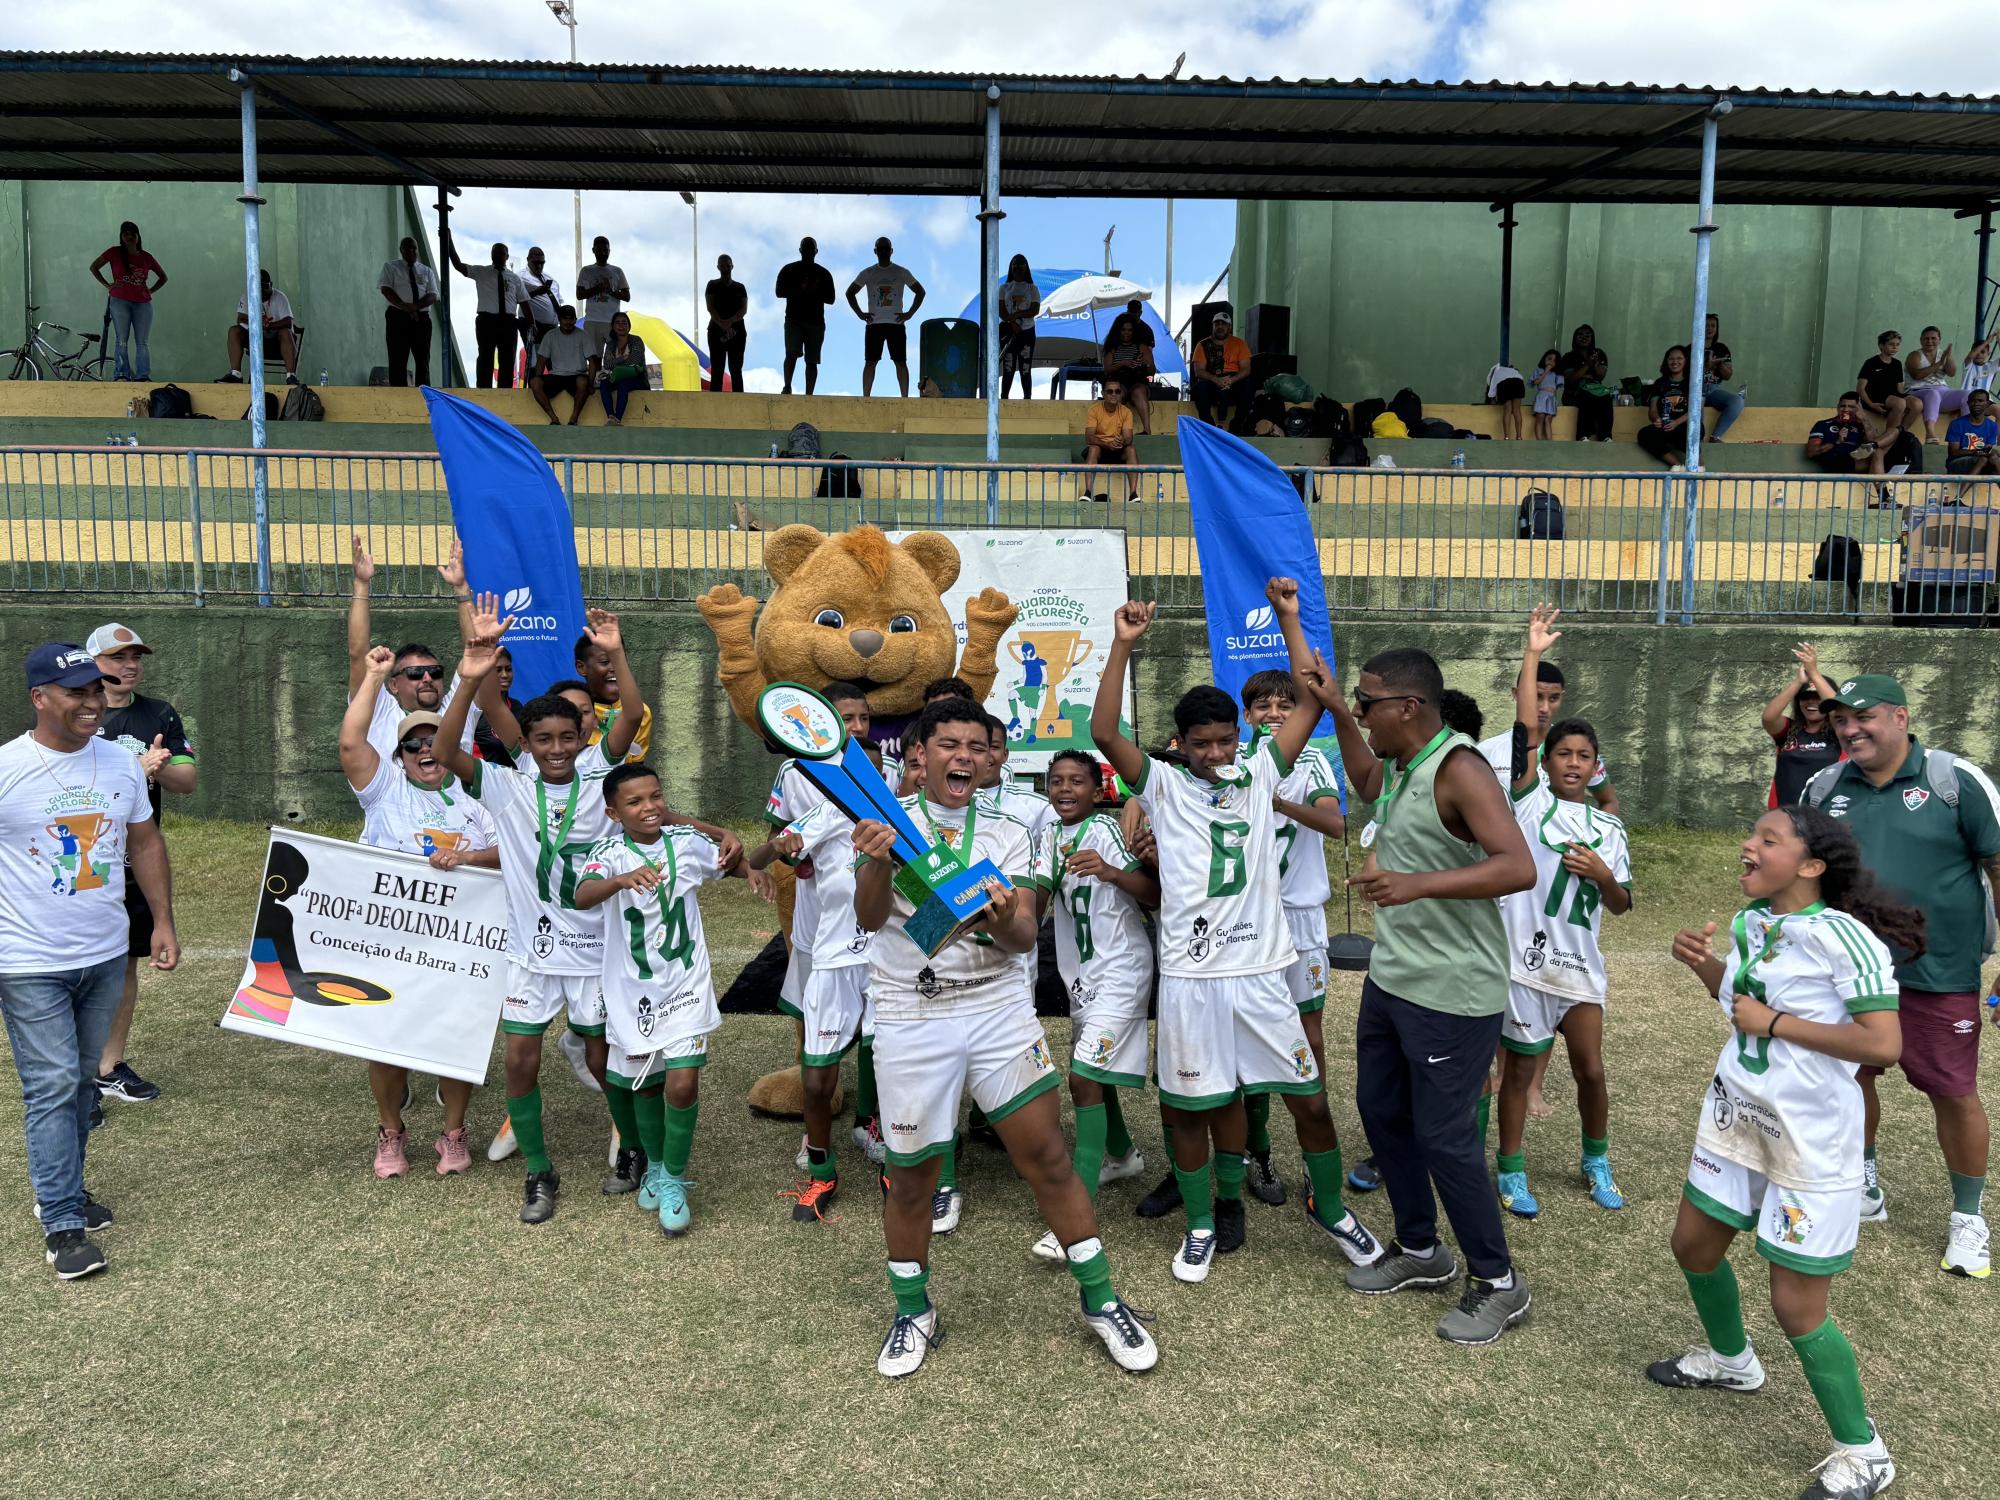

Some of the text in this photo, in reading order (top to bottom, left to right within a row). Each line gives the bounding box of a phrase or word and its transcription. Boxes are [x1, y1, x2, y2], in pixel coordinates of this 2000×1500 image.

[503, 616, 557, 631] zano
[1226, 633, 1286, 650] suzan
[1240, 652, 1273, 661] plantamos
[1207, 820, 1251, 897] 6
[928, 861, 958, 883] suzano
[371, 872, 457, 907] EMEF
[954, 873, 999, 906] CAMPEÃO
[365, 902, 458, 942] DEOLINDA
[462, 922, 508, 952] LAGE
[624, 896, 696, 979] 14
[1226, 932, 1258, 946] Floresta
[310, 930, 391, 958] Conceição
[395, 946, 412, 963] da
[415, 950, 456, 973] Barra
[468, 962, 491, 980] ES
[1550, 958, 1560, 968] da
[658, 997, 700, 1019] da Floresta
[1734, 1096, 1778, 1122] Guardiões
[1738, 1112, 1781, 1139] da Floresta
